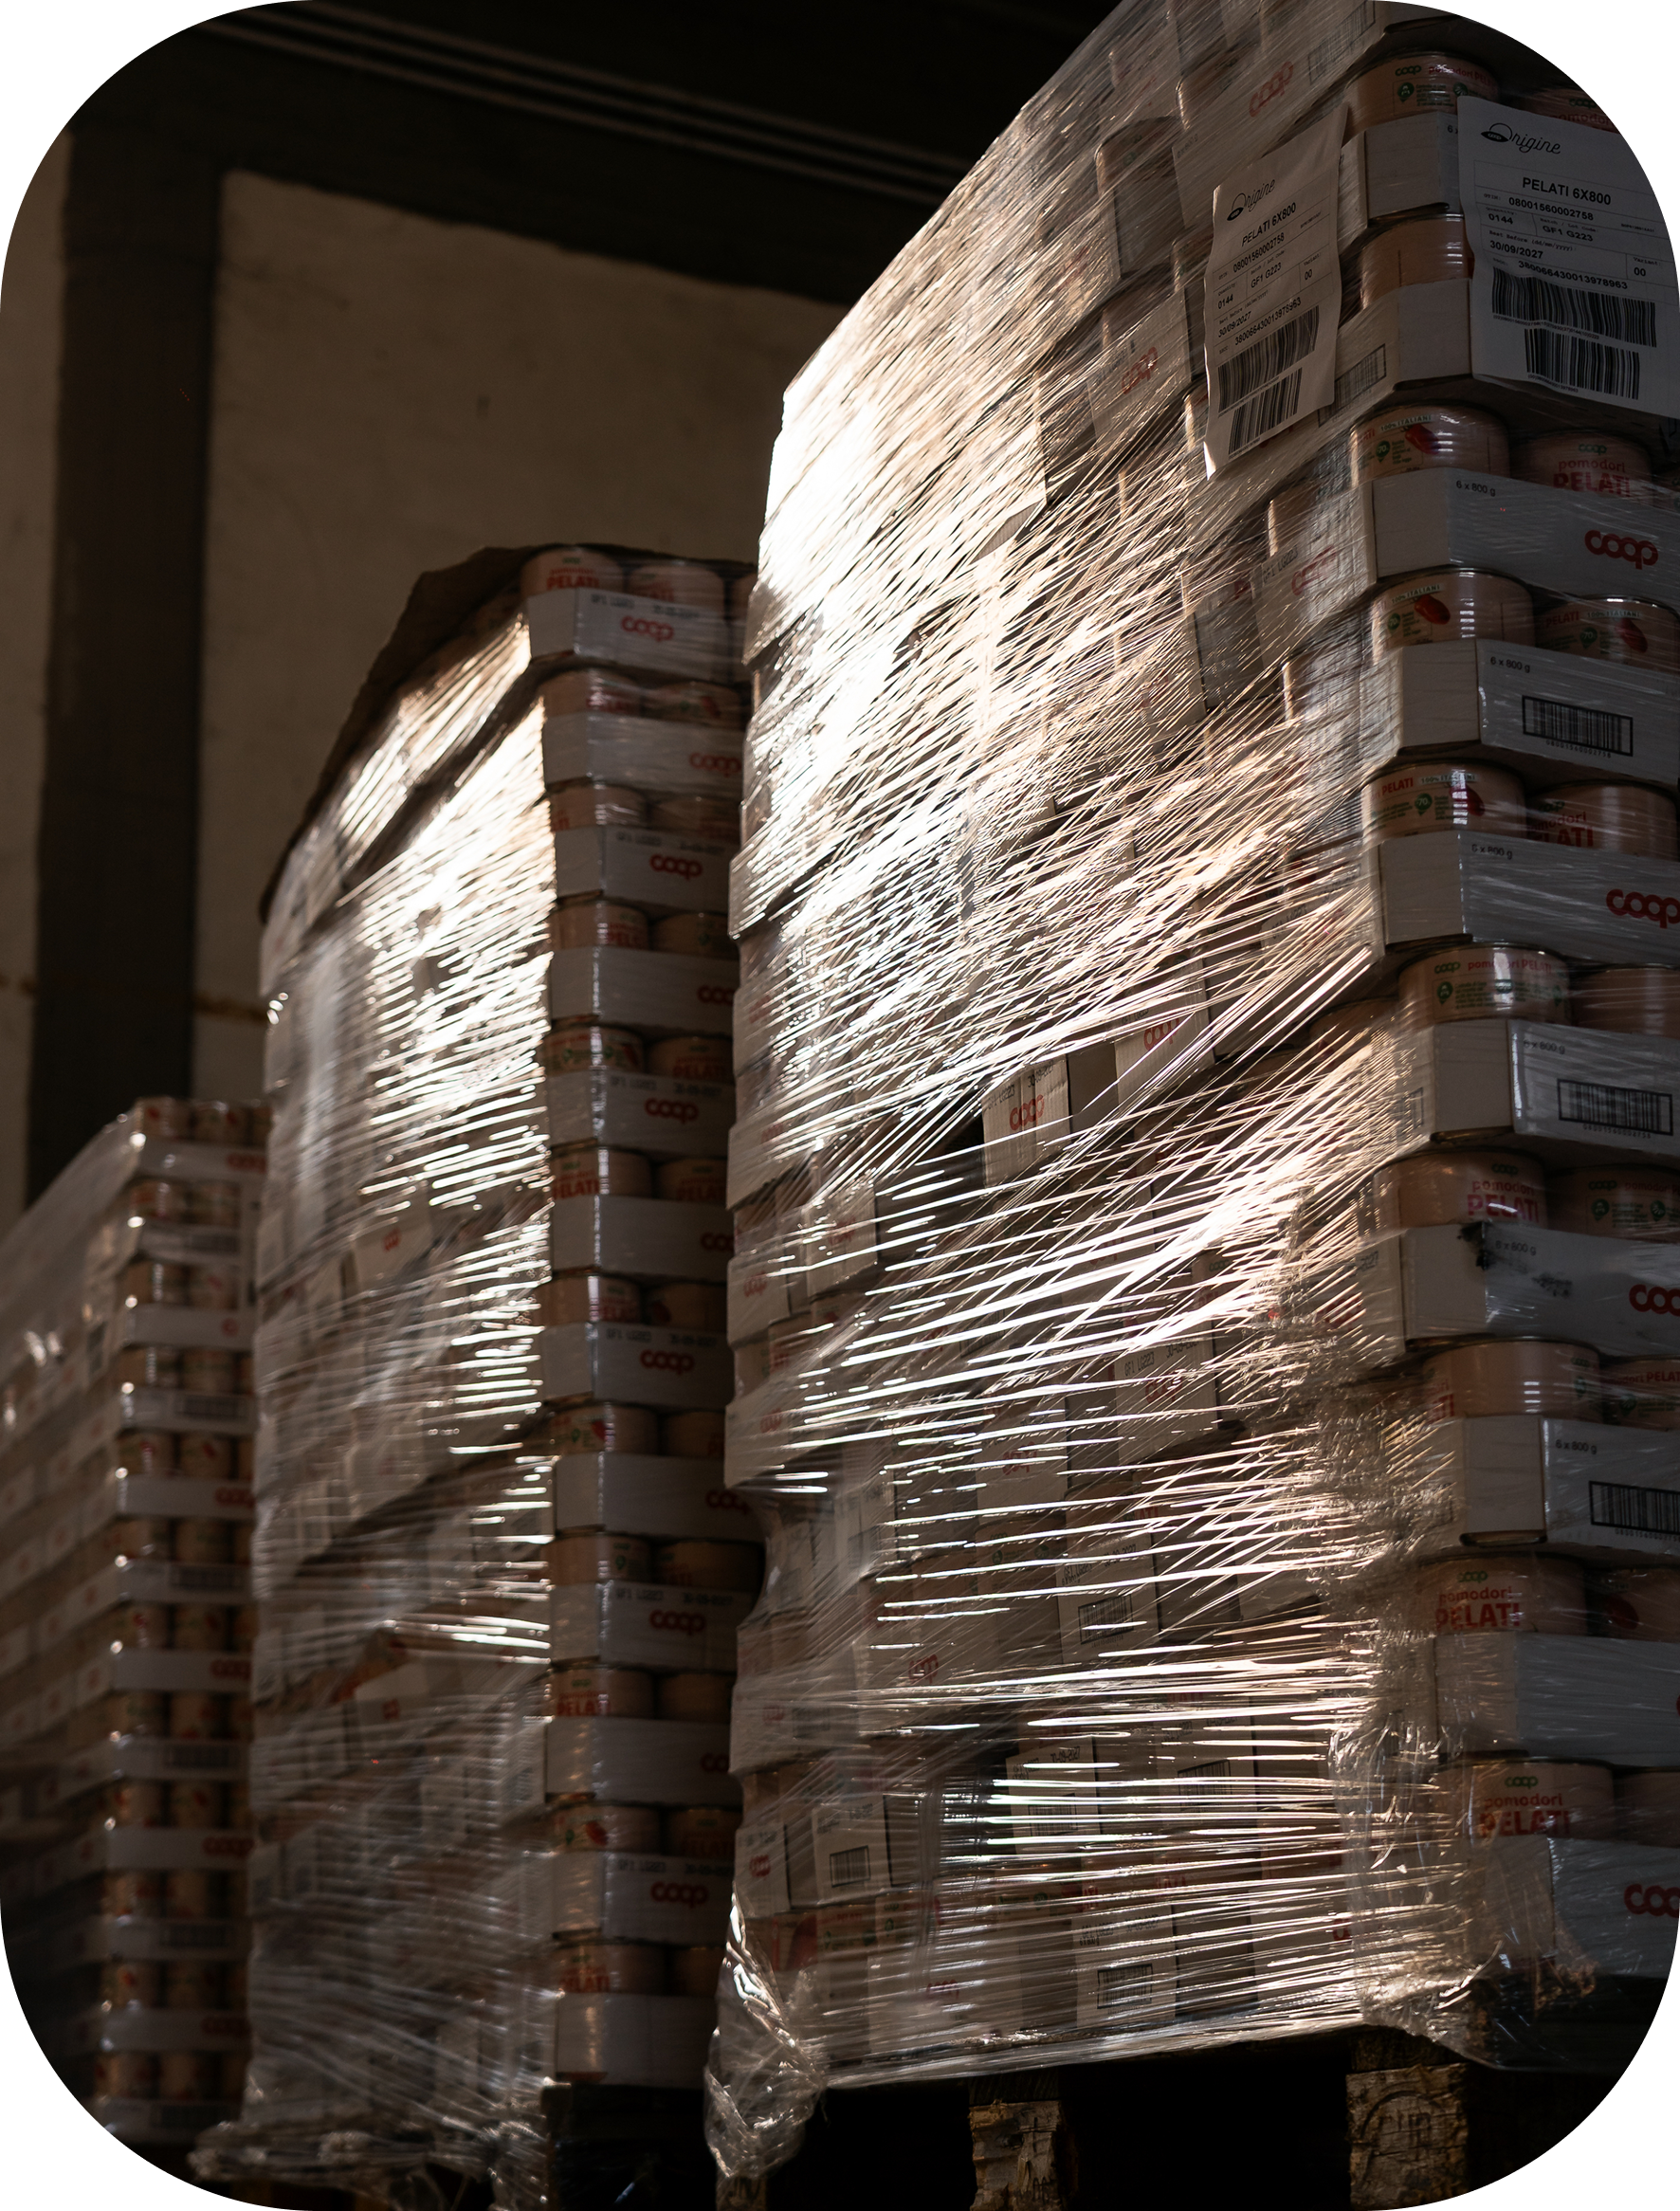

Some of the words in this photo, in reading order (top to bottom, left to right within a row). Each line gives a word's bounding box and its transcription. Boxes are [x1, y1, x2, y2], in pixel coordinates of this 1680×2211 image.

[1395, 64, 1422, 76] coop
[1429, 65, 1473, 78] poodori
[1249, 61, 1293, 117] coop
[1523, 176, 1569, 196] PELATI
[1573, 189, 1612, 205] 6X800
[1488, 212, 1513, 225] 0144
[1508, 196, 1594, 221] 08001560002758
[1241, 218, 1270, 247] PELATI
[1271, 202, 1296, 226] 6X800
[1543, 225, 1562, 235] GF1
[1566, 229, 1594, 242] G223
[1233, 232, 1285, 273] 08001560002758
[1489, 239, 1543, 259] 30/09/2027
[1251, 275, 1264, 288] GF1
[1265, 262, 1282, 279] G223
[1304, 268, 1313, 281] 00
[1518, 260, 1628, 289] 380066430013978963
[1634, 266, 1647, 277] 00
[1217, 294, 1233, 309] 0144
[1218, 310, 1251, 338] 30/09/2027
[1122, 347, 1158, 395] coop
[1397, 414, 1432, 426] ITALIANI
[1579, 443, 1607, 455] coop
[1559, 461, 1626, 474] pomodori
[1471, 482, 1488, 493] 800
[1553, 473, 1631, 498] PELATI
[1584, 529, 1658, 569] coop
[1407, 584, 1440, 597] ITALIANI
[622, 615, 674, 642] coop
[1545, 611, 1580, 627] PELATI
[1506, 659, 1523, 671] 800
[689, 751, 742, 777] coop
[1381, 777, 1414, 795] PELATI
[649, 854, 703, 881] coop
[1606, 888, 1680, 928] coop
[1433, 961, 1461, 974] coop
[1468, 959, 1520, 971] pomri
[698, 985, 736, 1006] coo
[645, 1097, 699, 1124] coop
[1010, 1094, 1045, 1131] coop
[1491, 1162, 1518, 1176] coop
[1588, 1180, 1617, 1191] coop
[1468, 1194, 1540, 1223] PELATI
[1629, 1284, 1680, 1317] coo
[640, 1349, 695, 1375] coop
[1646, 1370, 1680, 1382] PELAT
[1571, 1440, 1589, 1453] 800
[1438, 1585, 1513, 1604] pomodori
[649, 1610, 705, 1635] coop
[1434, 1602, 1520, 1632] PELATI
[1505, 1776, 1538, 1788] coop
[1484, 1793, 1562, 1808] pomodori
[1479, 1809, 1570, 1837] PELATI
[650, 1881, 708, 1909] coop
[1624, 1884, 1680, 1918] coo
